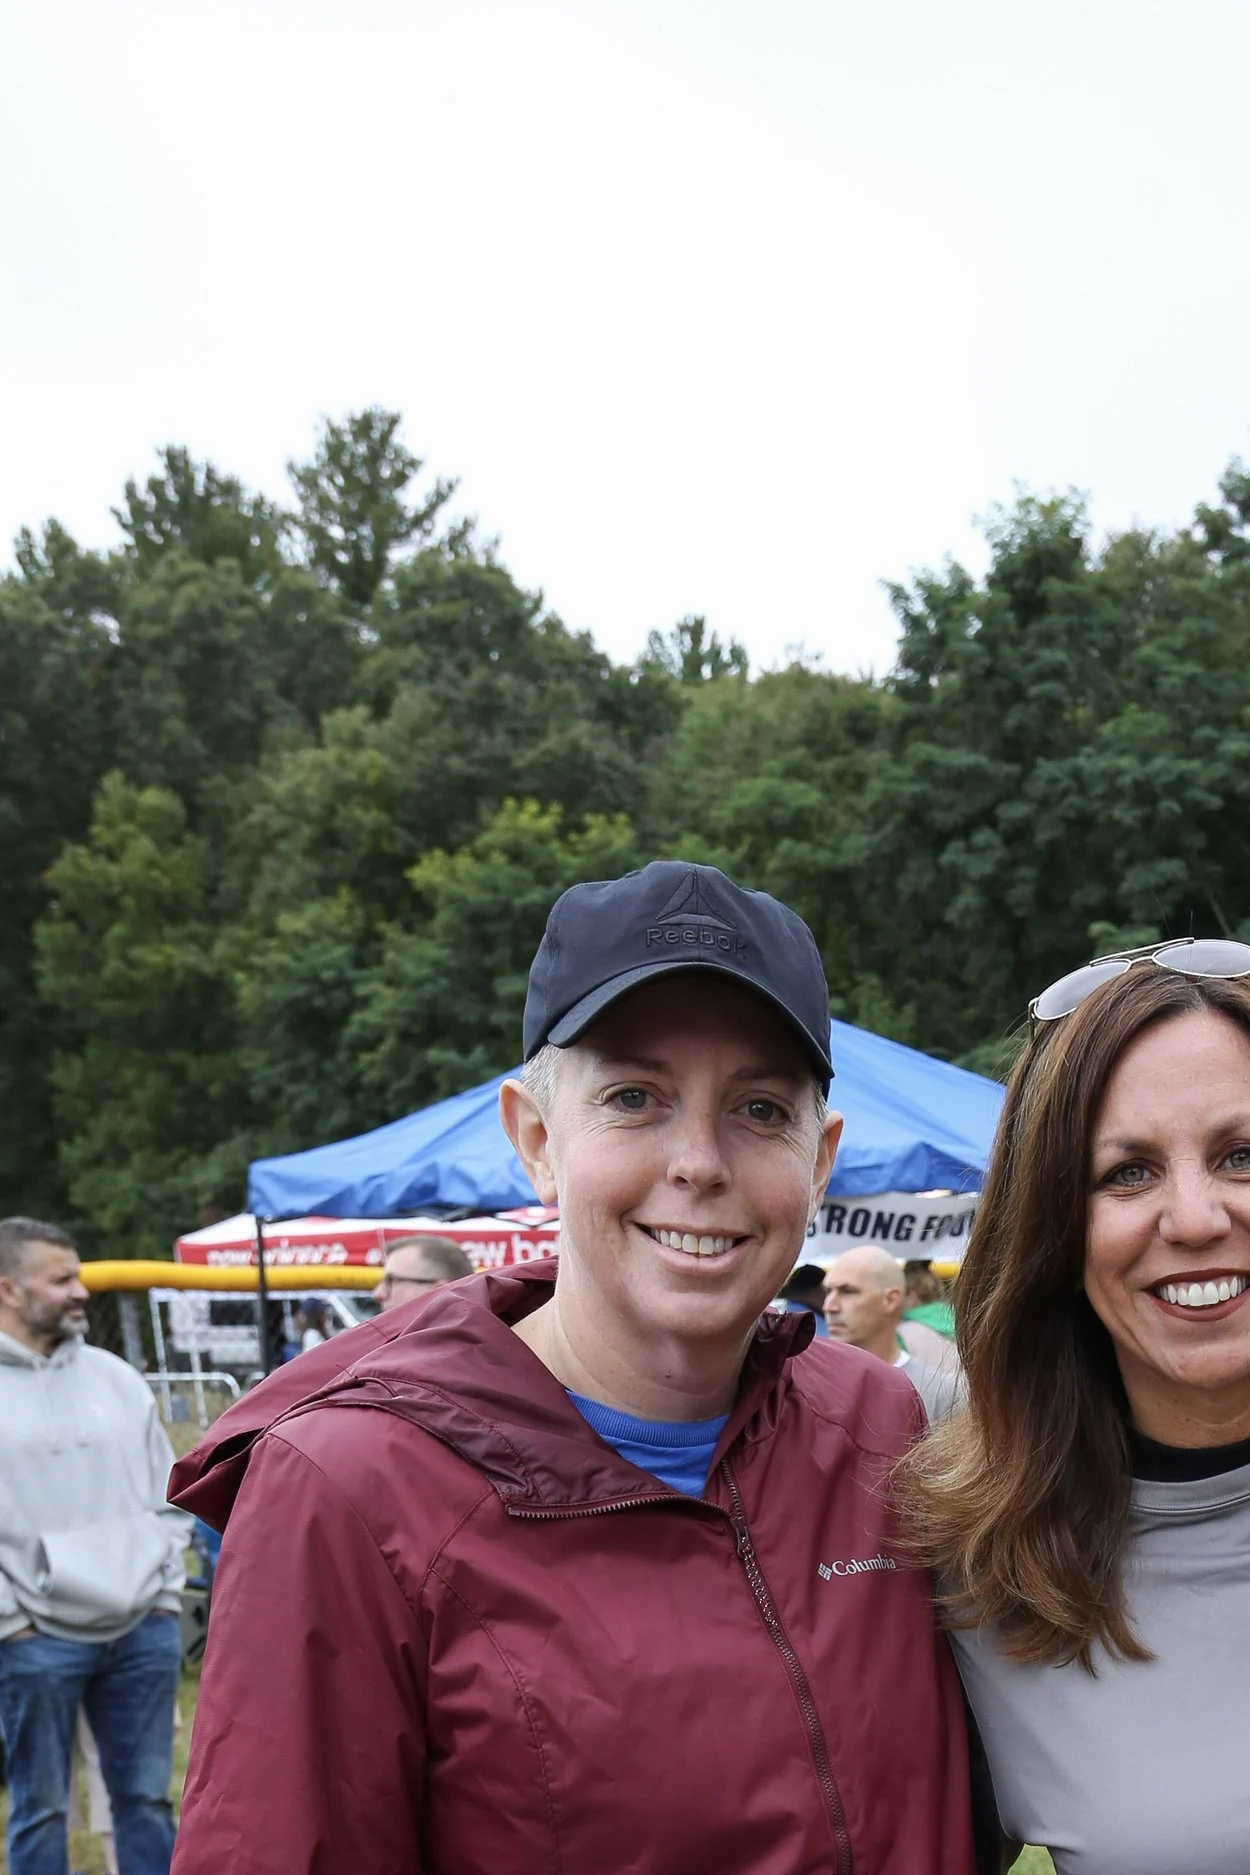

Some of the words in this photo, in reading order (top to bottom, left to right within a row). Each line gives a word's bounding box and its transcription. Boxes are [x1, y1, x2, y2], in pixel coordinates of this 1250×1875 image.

[646, 928, 748, 961] Reebok
[806, 1203, 916, 1241] RONG
[920, 1209, 976, 1241] FOU
[462, 1239, 507, 1267] ew
[832, 1554, 896, 1575] Columbia
